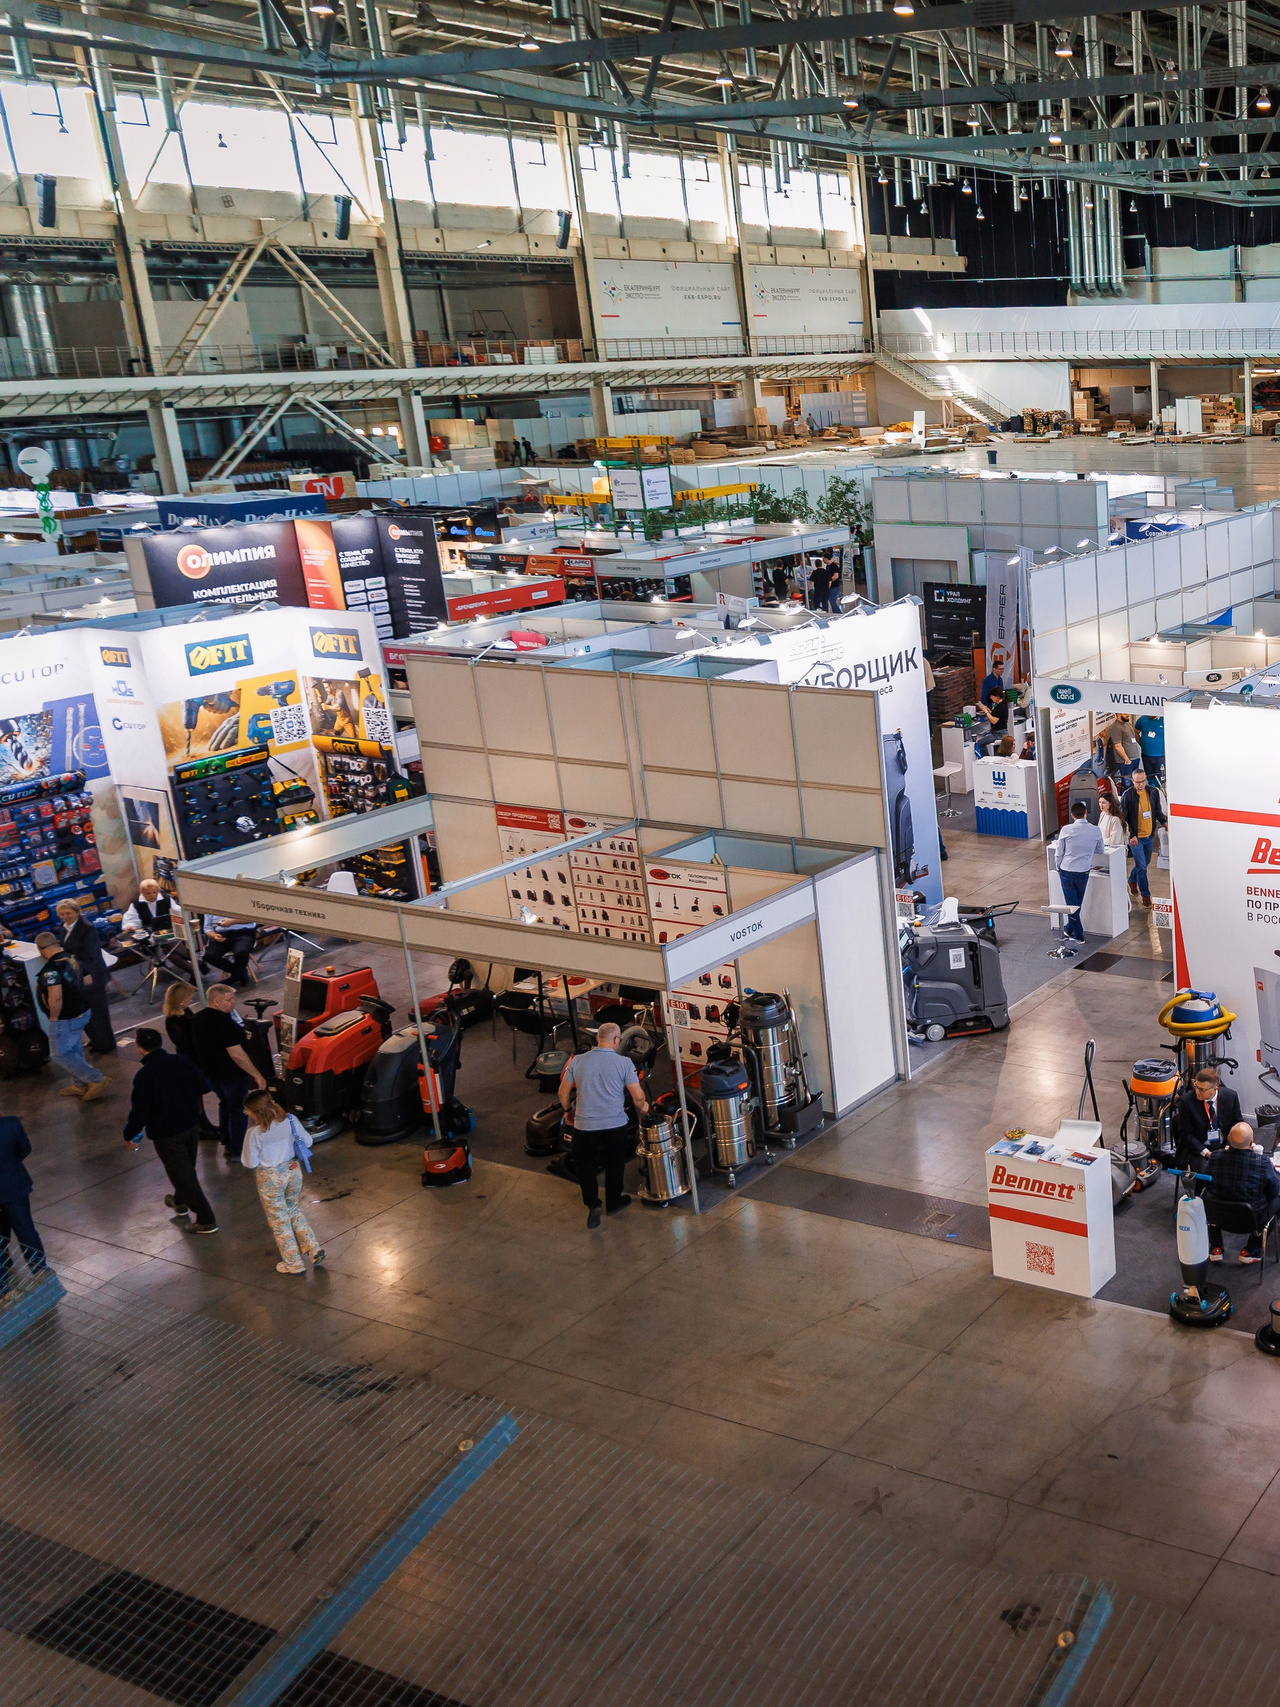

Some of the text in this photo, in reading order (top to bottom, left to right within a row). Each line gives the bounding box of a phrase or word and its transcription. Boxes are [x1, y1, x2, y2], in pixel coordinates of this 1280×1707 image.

[186, 545, 277, 569] ОЛИМПИЯ
[192, 578, 278, 600] КОМПЛЕКТАЦИЯ
[250, 899, 326, 920] Уборочная техника
[1153, 904, 1171, 912] E201
[1246, 899, 1263, 911] ПО
[1246, 912, 1255, 922] В
[729, 920, 764, 943] VOSTOK
[670, 1000, 688, 1010] E101
[991, 1164, 1076, 1200] Bennett
